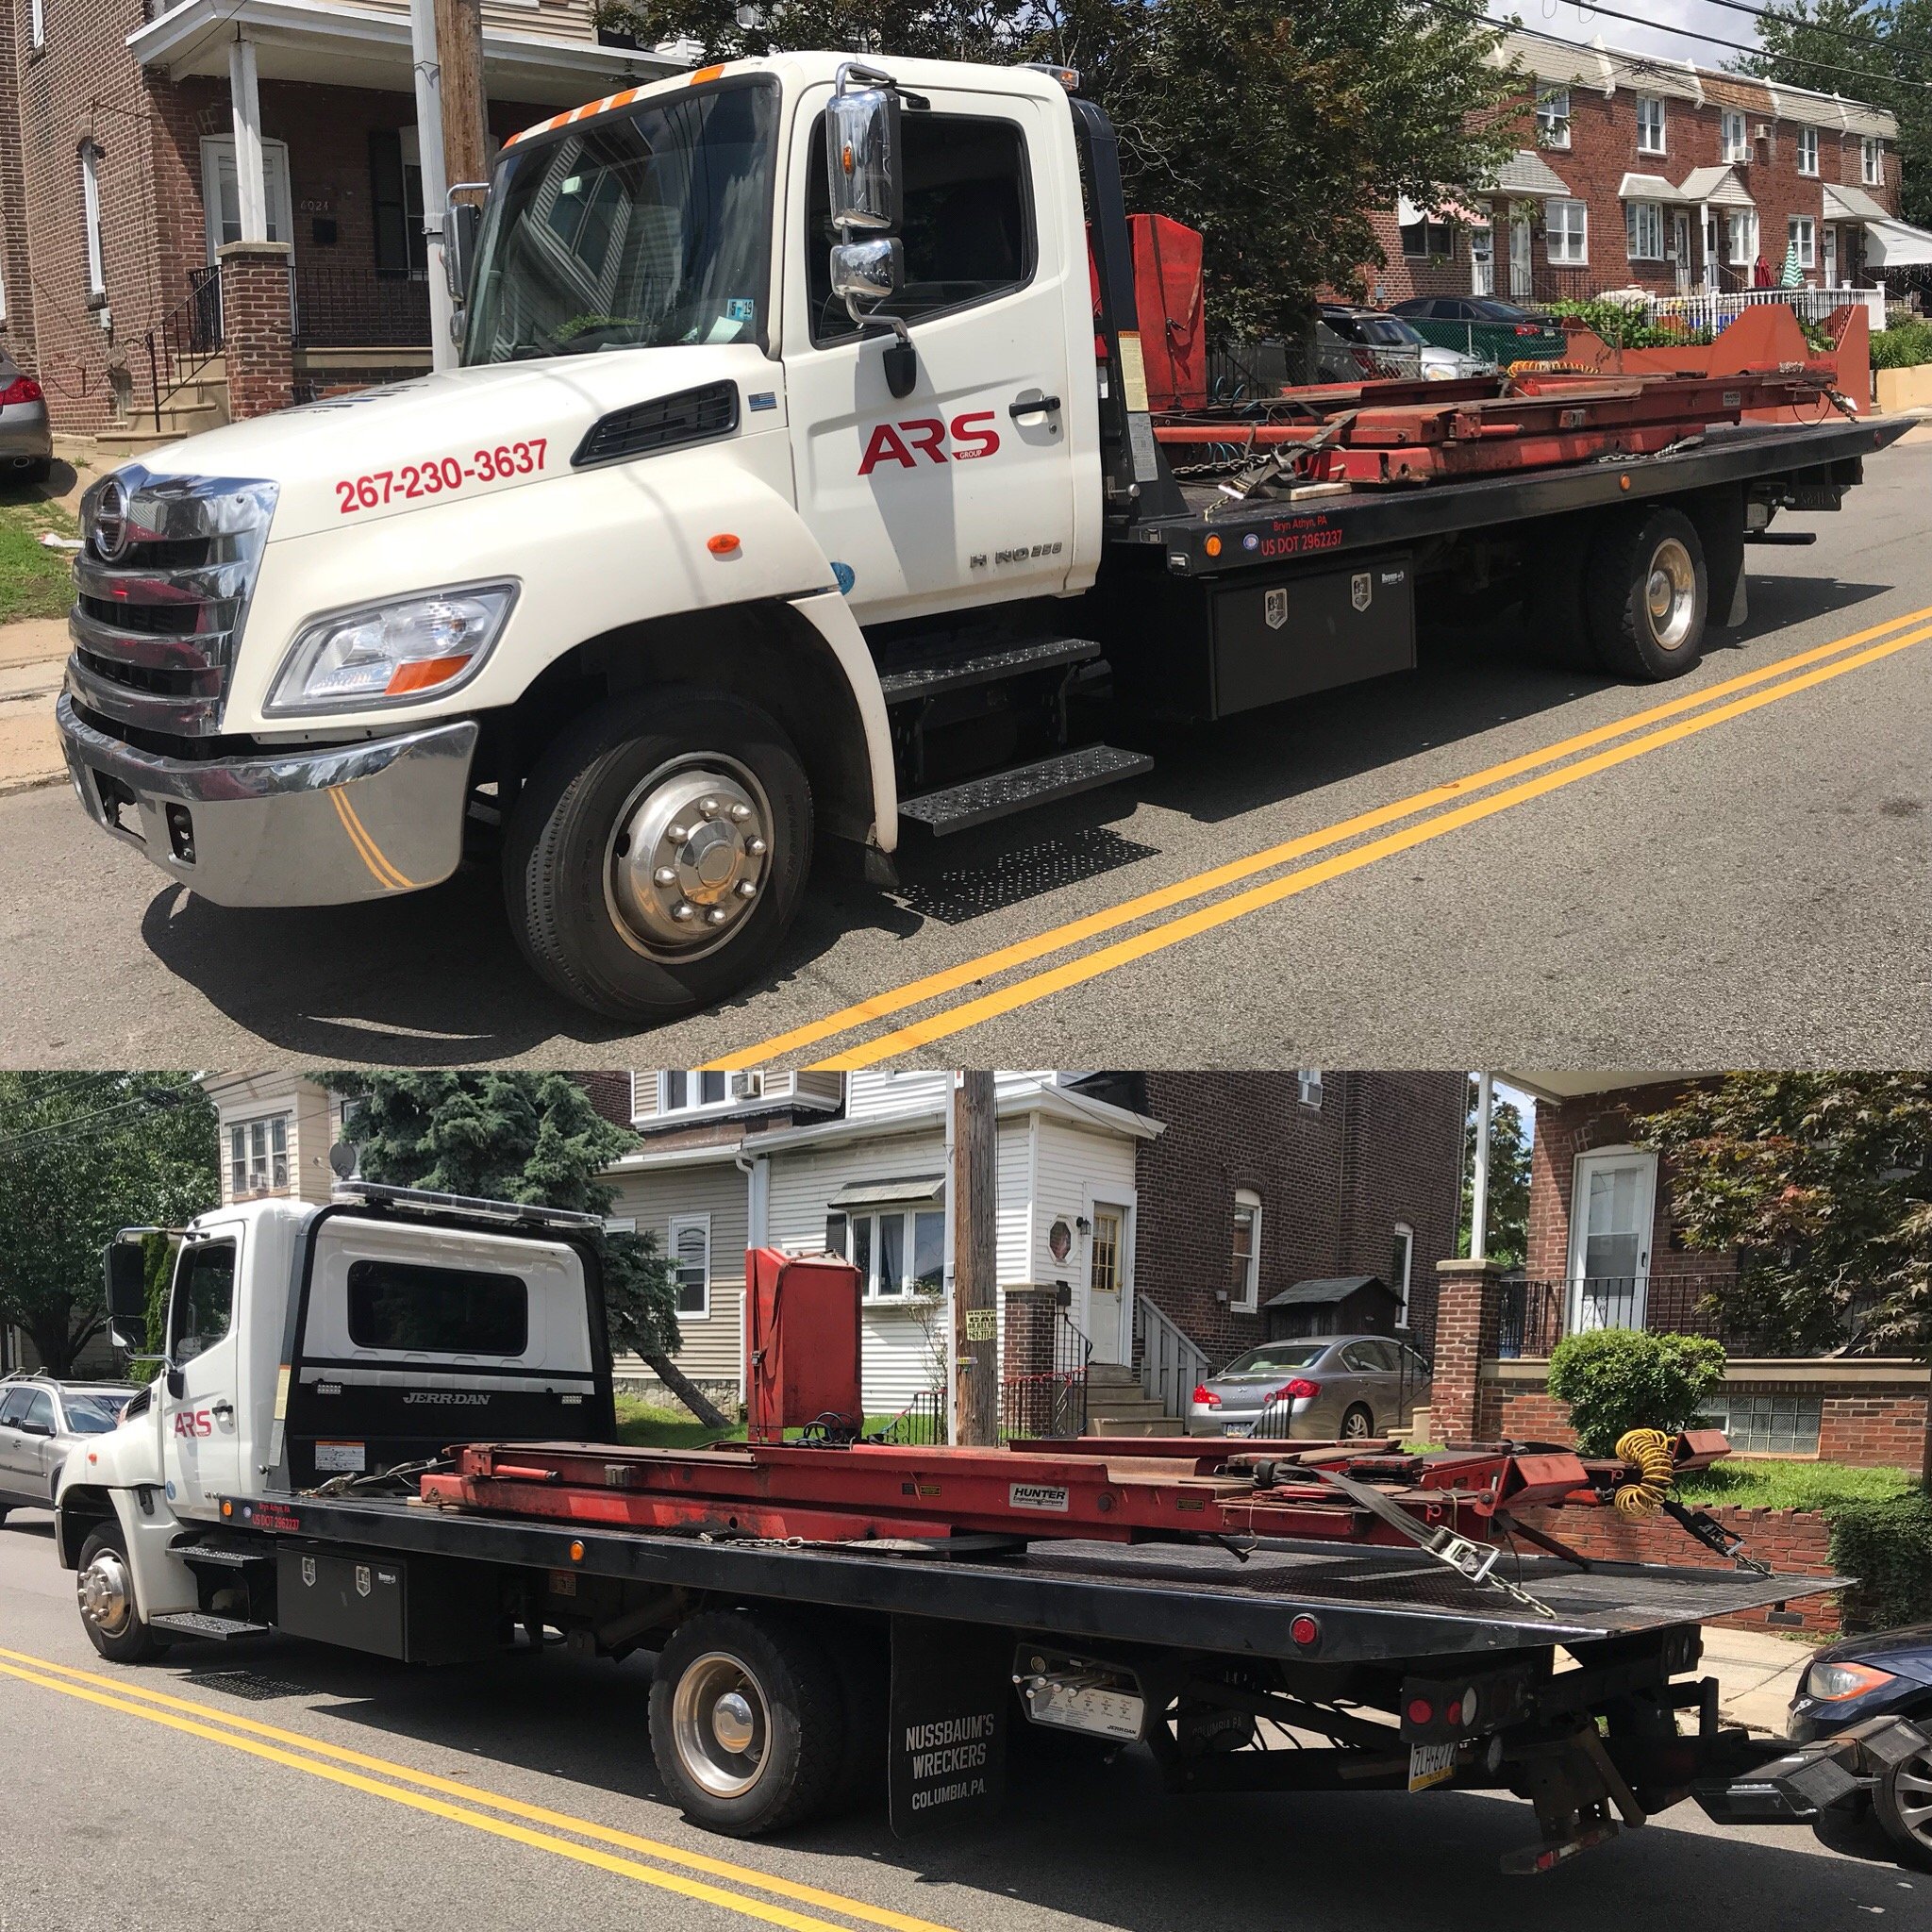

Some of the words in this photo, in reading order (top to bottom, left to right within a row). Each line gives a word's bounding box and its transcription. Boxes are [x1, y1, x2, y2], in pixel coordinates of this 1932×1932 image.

[300, 200, 329, 211] 6024
[858, 410, 1001, 475] ARS
[959, 449, 982, 459] GROUP
[335, 438, 548, 514] 267-230-3637
[1273, 521, 1291, 533] Bryn
[1317, 514, 1328, 525] PA
[1261, 539, 1275, 556] US
[1277, 535, 1299, 554] DOT
[1301, 529, 1343, 550] 2962237
[402, 1392, 491, 1406] JERR-DAN
[174, 1410, 212, 1438] ARS
[1013, 1495, 1040, 1504] Engineering
[1041, 1498, 1064, 1507] Company
[1014, 1487, 1066, 1500] HUNTER
[906, 1713, 995, 1752] NUSSBAUM'S
[912, 1742, 988, 1780] WRECKERS
